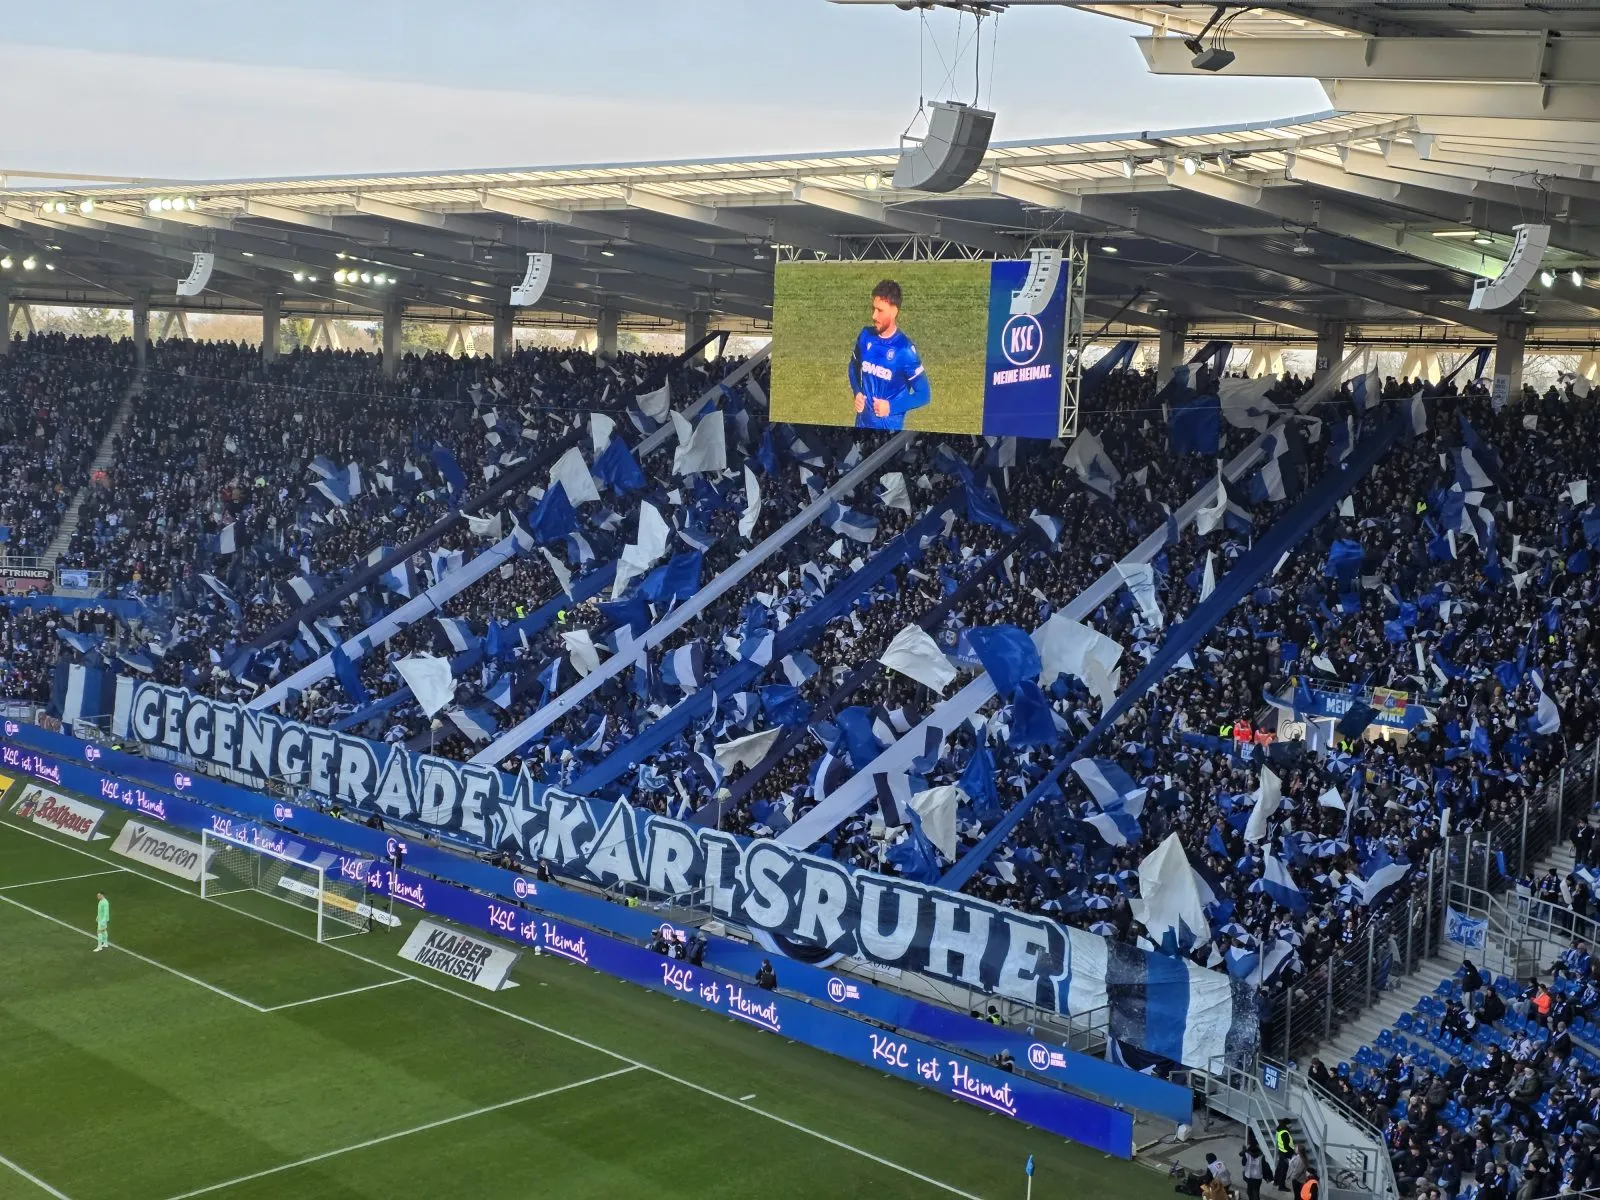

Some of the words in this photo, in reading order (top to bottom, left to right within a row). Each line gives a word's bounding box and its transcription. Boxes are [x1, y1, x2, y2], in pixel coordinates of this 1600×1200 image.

[1011, 324, 1034, 353] KSC
[993, 368, 1019, 386] MEINE
[1018, 364, 1052, 382] HEIMAT.
[2, 746, 20, 765] KSC
[21, 756, 32, 771] ist
[100, 778, 119, 799] KSC
[121, 789, 134, 806] ist
[35, 796, 94, 834] Rothaus
[211, 815, 232, 836] KSC
[235, 827, 249, 844] ist
[133, 684, 497, 846] GEGENGERADE
[535, 791, 1060, 1010] KARLSRUHE
[139, 835, 198, 870] macron
[339, 856, 364, 880] KSC
[367, 869, 383, 889] ist
[385, 871, 426, 909] Heimat.
[487, 904, 516, 932] KSC
[520, 921, 538, 942] ist
[541, 921, 589, 964] Heimat.
[414, 946, 483, 983] MARKISEN
[661, 962, 694, 993] KSC
[700, 981, 720, 1004] ist
[725, 983, 781, 1032] Heimat.
[869, 1033, 909, 1068] KSC
[916, 1057, 942, 1082] ist
[948, 1060, 1017, 1117] Heimat.
[1265, 1073, 1277, 1089] SW
